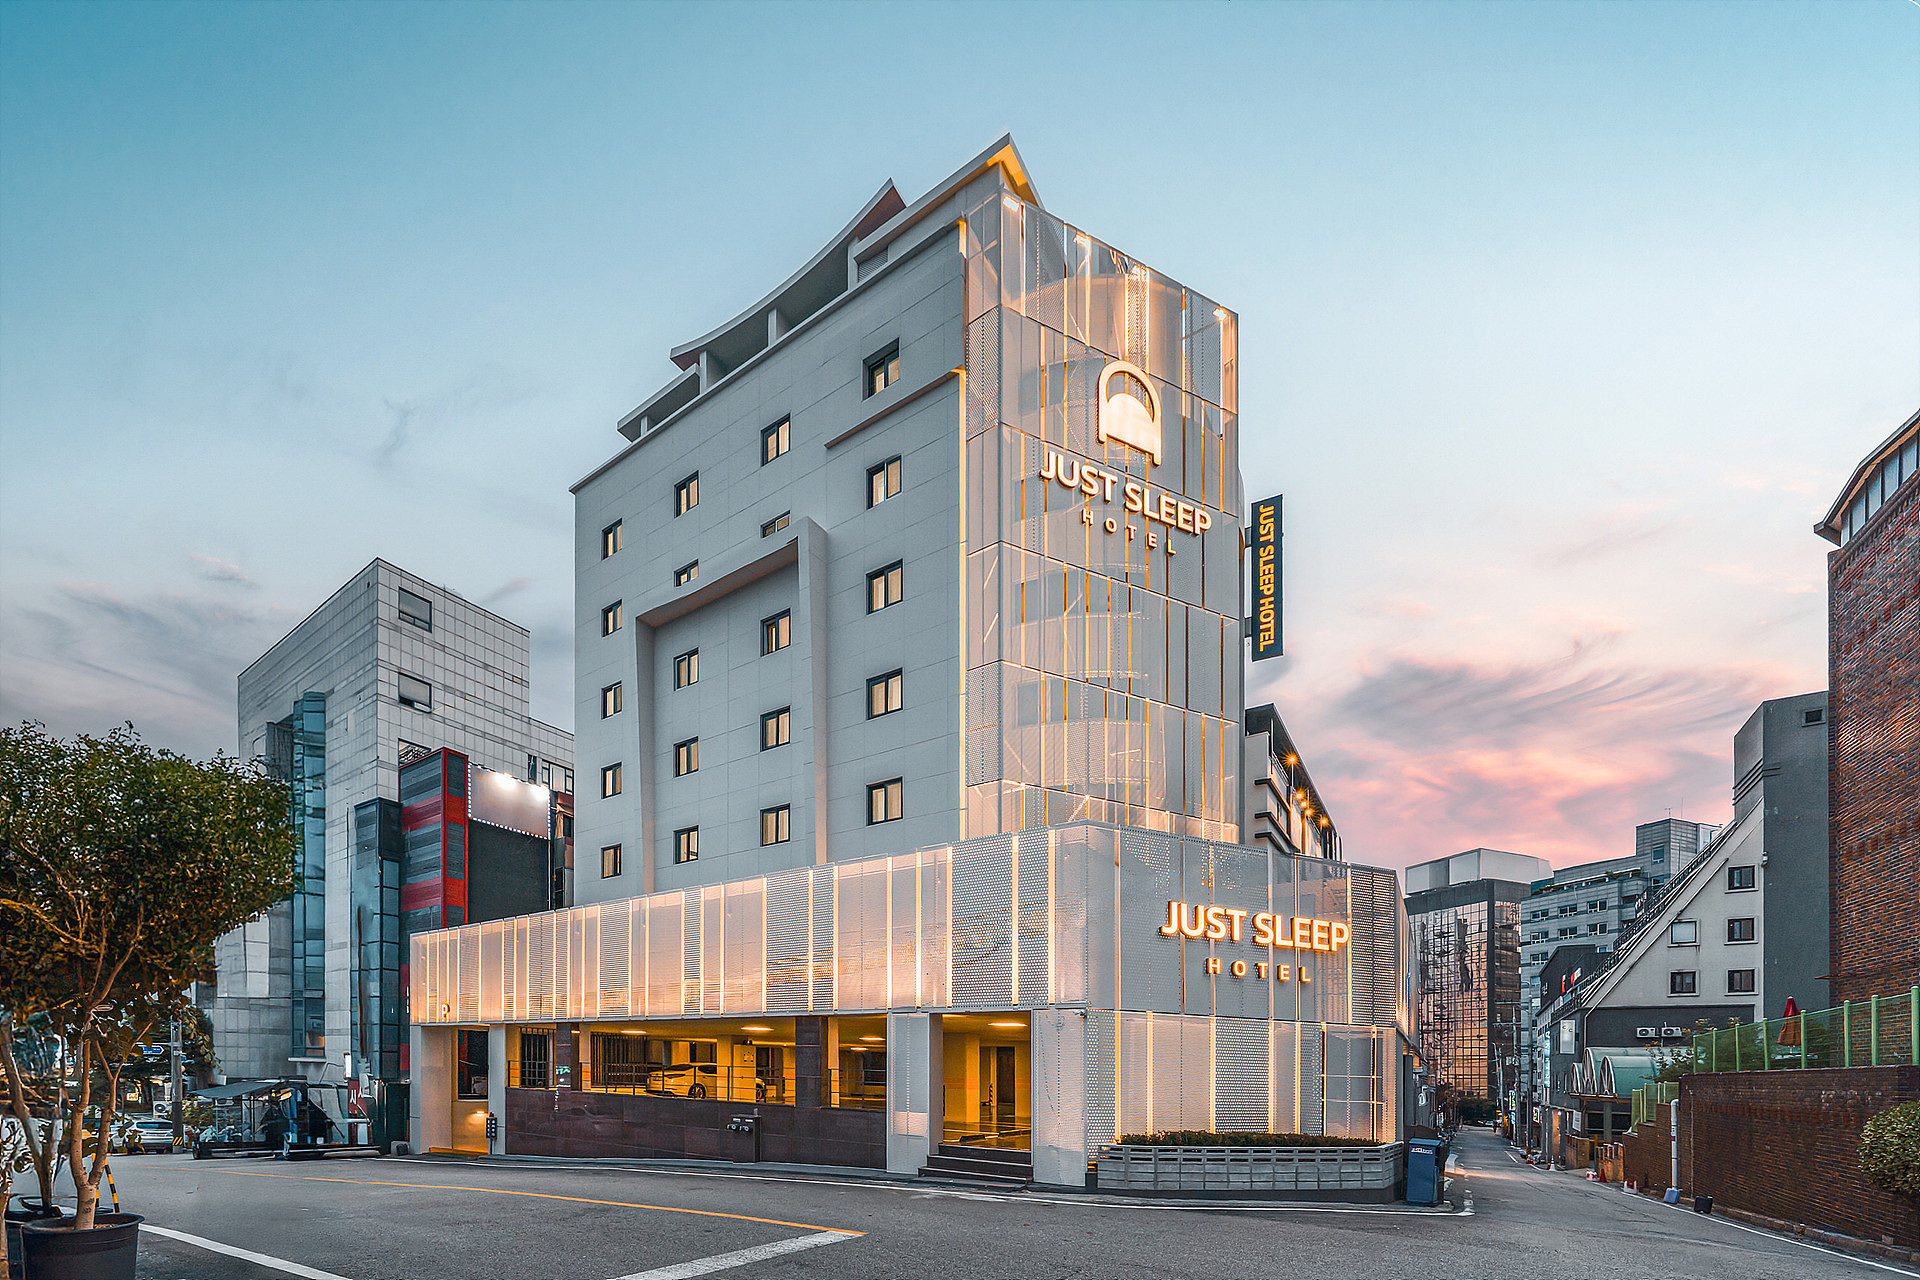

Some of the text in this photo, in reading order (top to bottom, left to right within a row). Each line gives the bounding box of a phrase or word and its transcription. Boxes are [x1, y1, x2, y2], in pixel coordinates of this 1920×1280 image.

[1040, 450, 1212, 536] JUST SLEEP
[1082, 507, 1176, 555] HOTEL
[1258, 504, 1275, 652] JUST SLEEP HOTEL
[1159, 900, 1349, 952] JUST SLEEP
[1206, 956, 1311, 983] HOTEL
